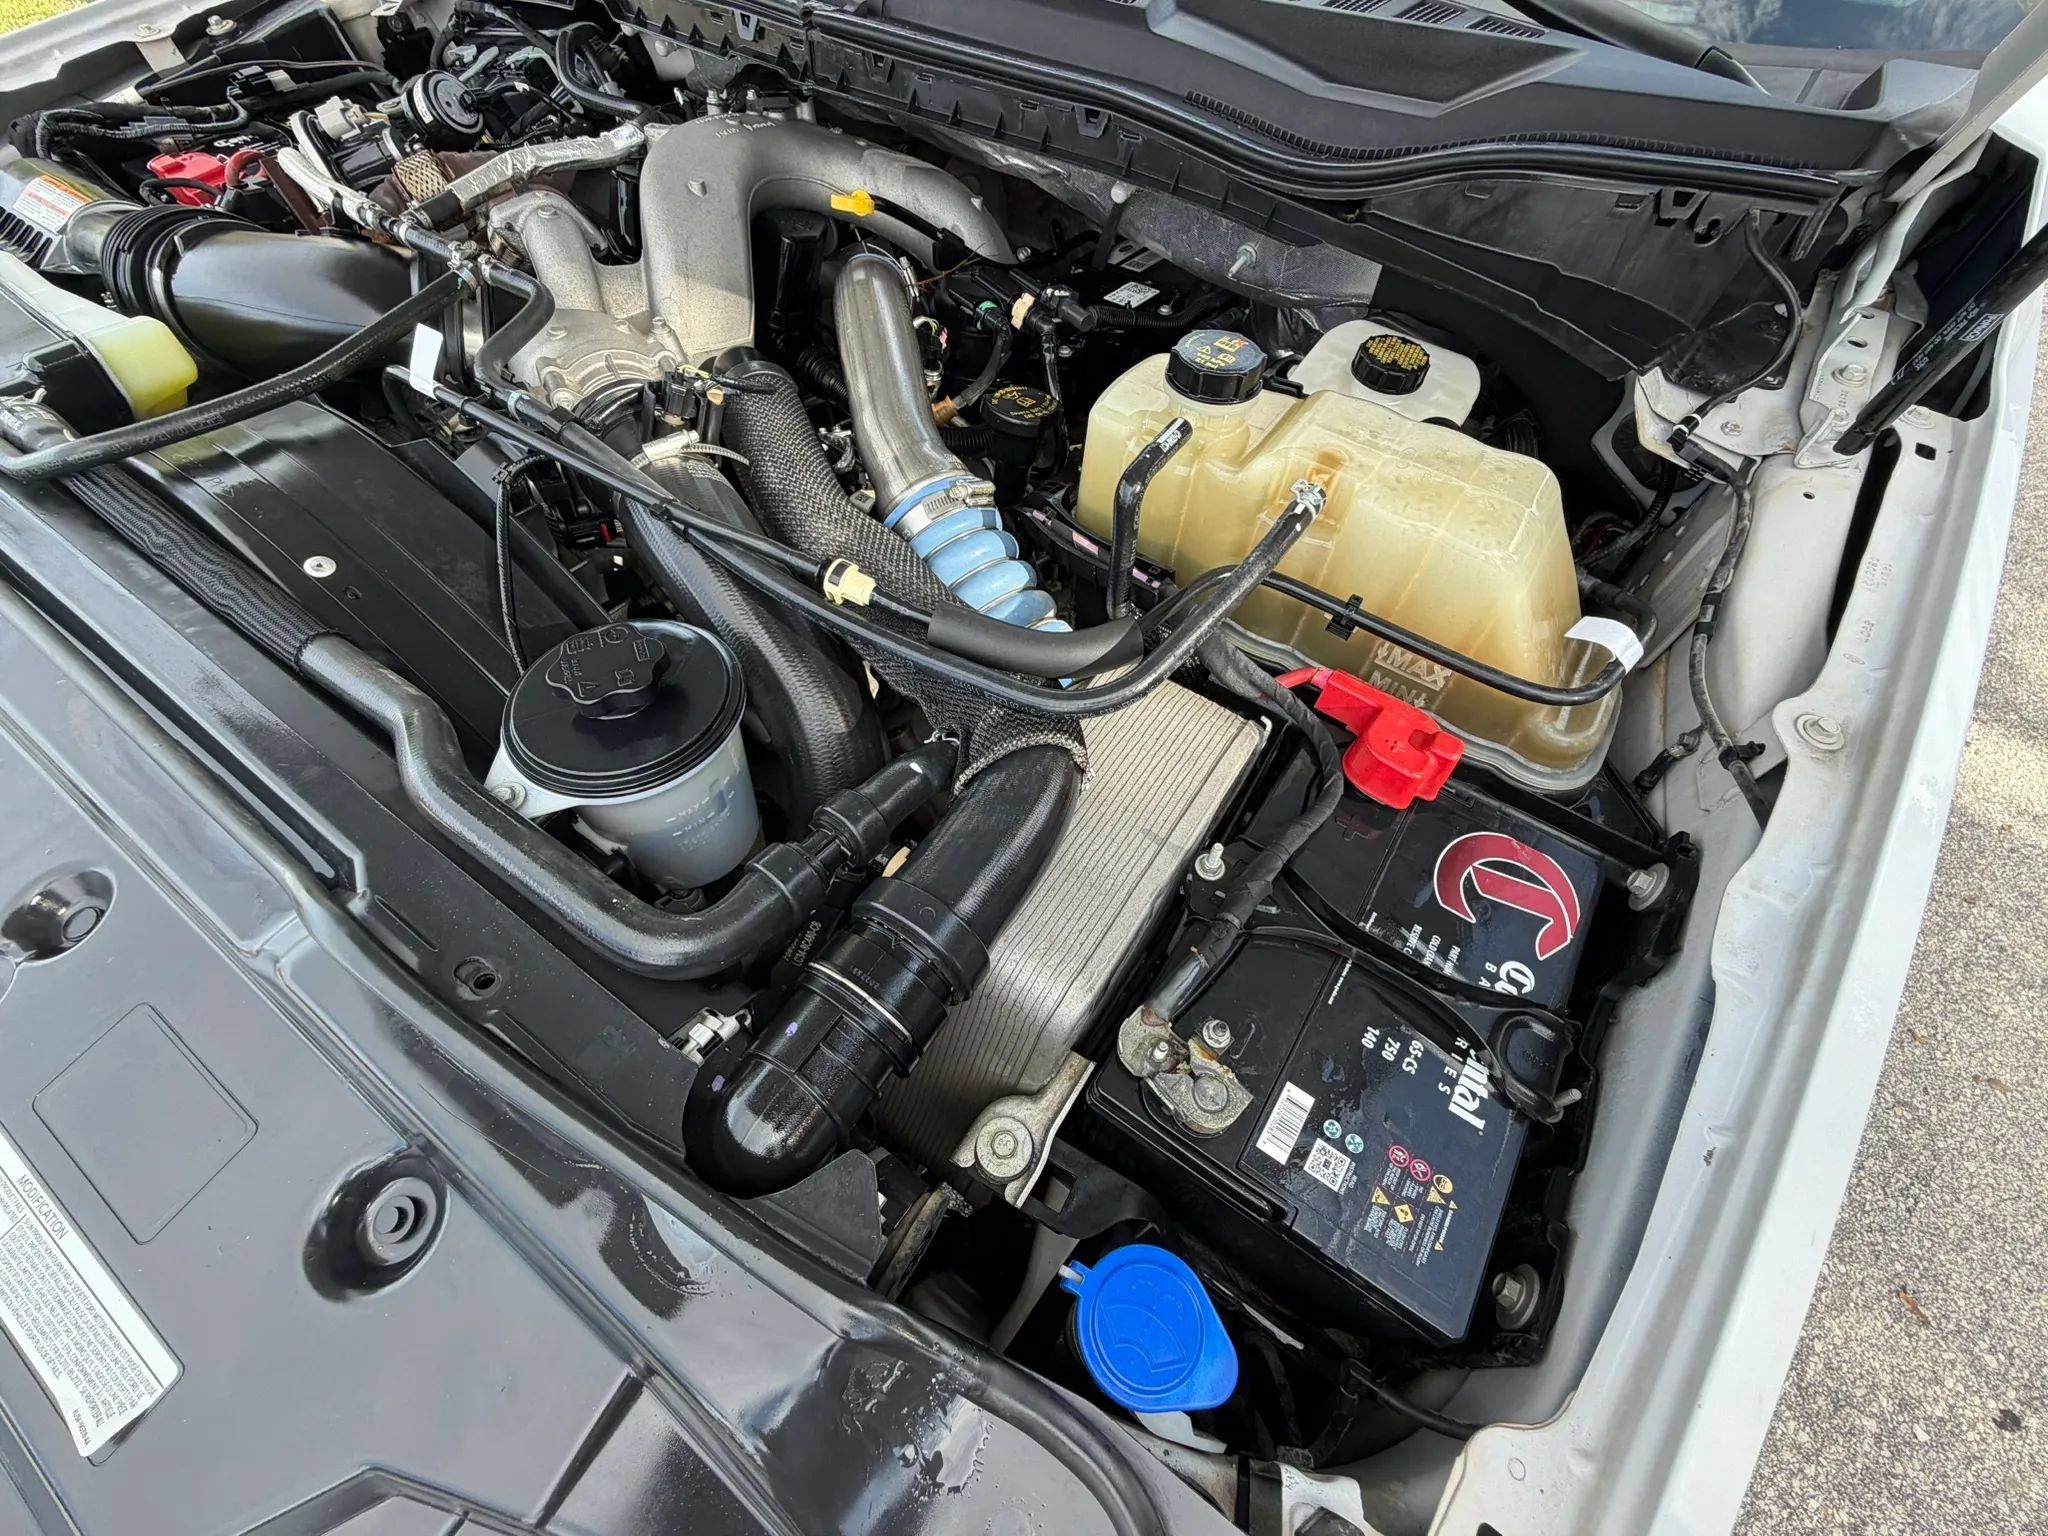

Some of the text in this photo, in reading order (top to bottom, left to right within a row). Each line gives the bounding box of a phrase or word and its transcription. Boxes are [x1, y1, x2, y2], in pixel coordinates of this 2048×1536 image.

[1386, 645, 1454, 689] MAX
[1369, 669, 1417, 703] MIN
[1361, 1025, 1380, 1049] 140
[1381, 1037, 1401, 1061] 750
[1402, 1040, 1425, 1075] 65-CS
[16, 1173, 69, 1240] MODIFICATION
